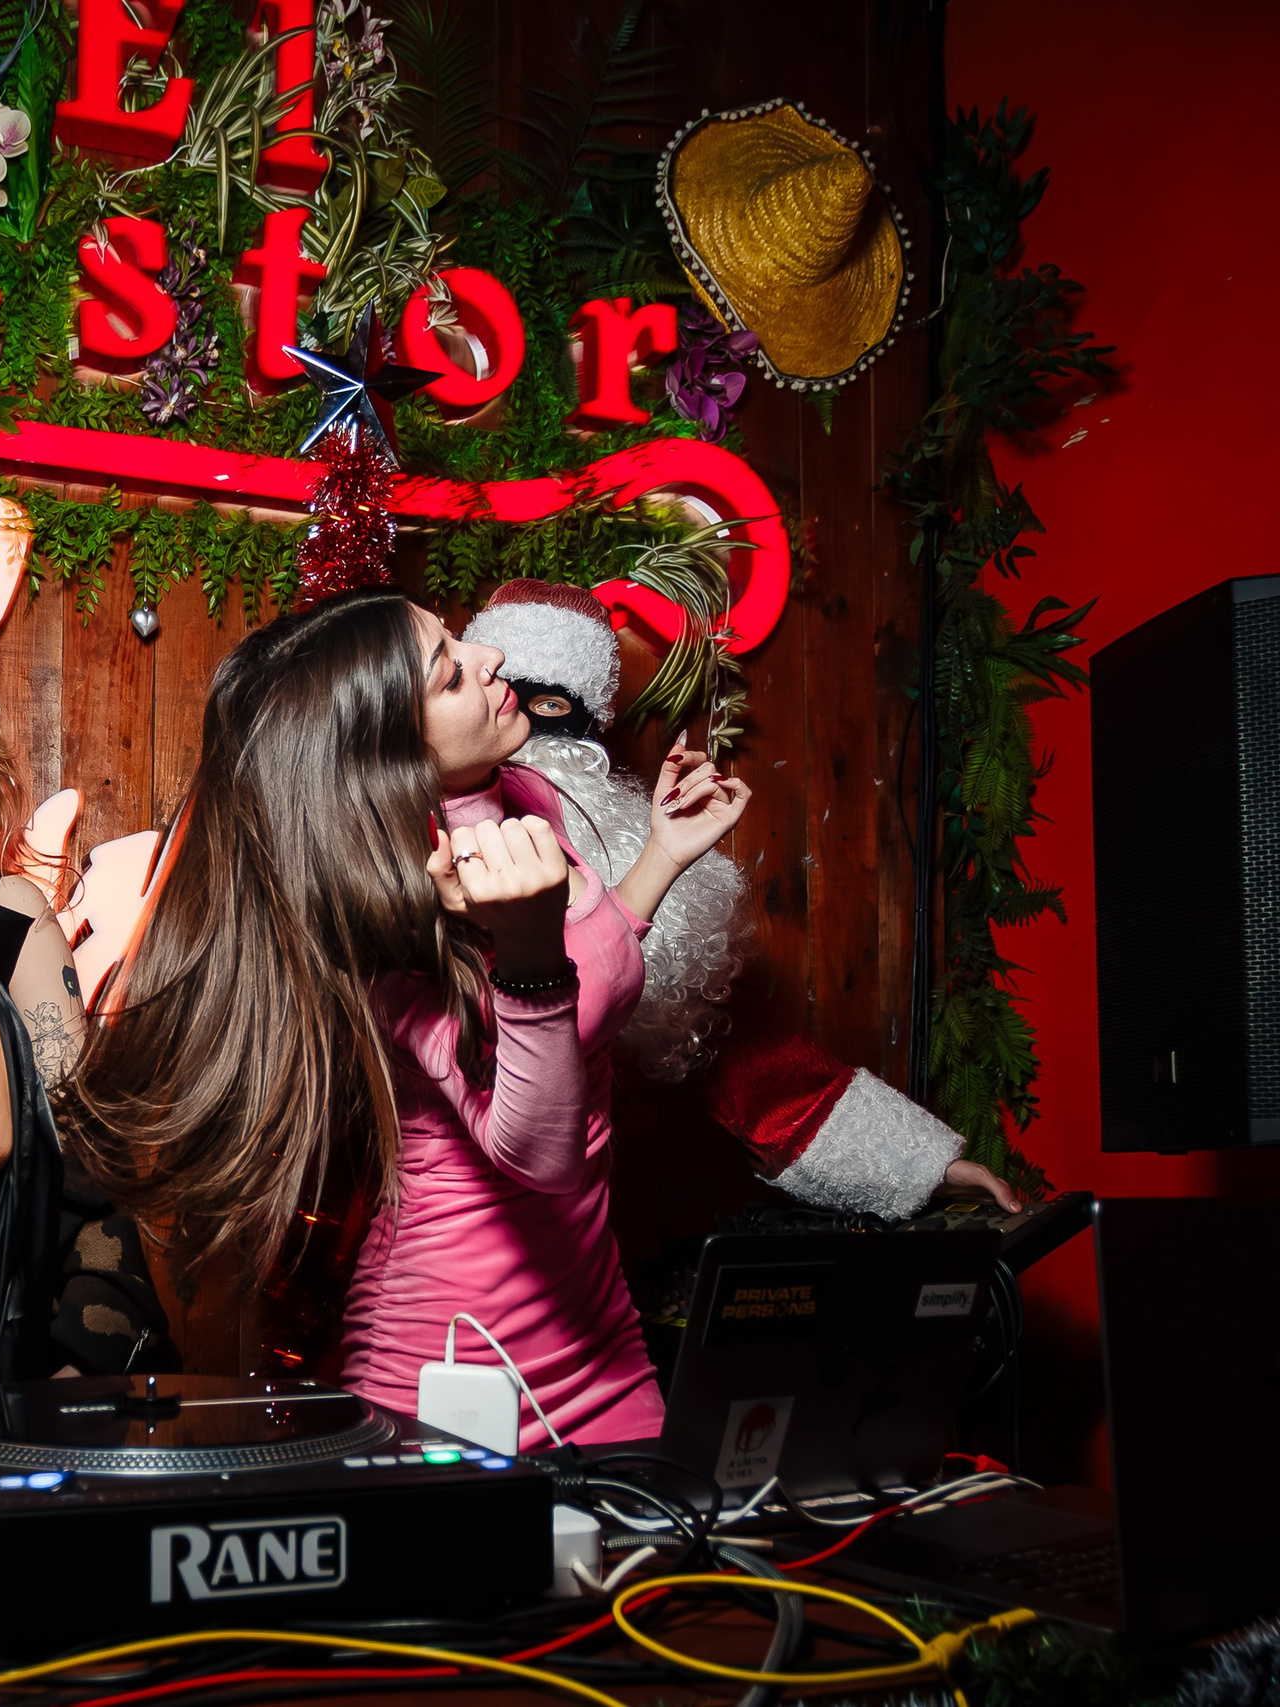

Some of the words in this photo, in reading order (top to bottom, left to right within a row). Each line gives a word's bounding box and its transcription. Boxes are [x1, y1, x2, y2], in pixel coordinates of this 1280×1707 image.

[53, 0, 328, 190] El
[734, 1285, 813, 1303] PRIVATE
[150, 1524, 336, 1604] RANE
